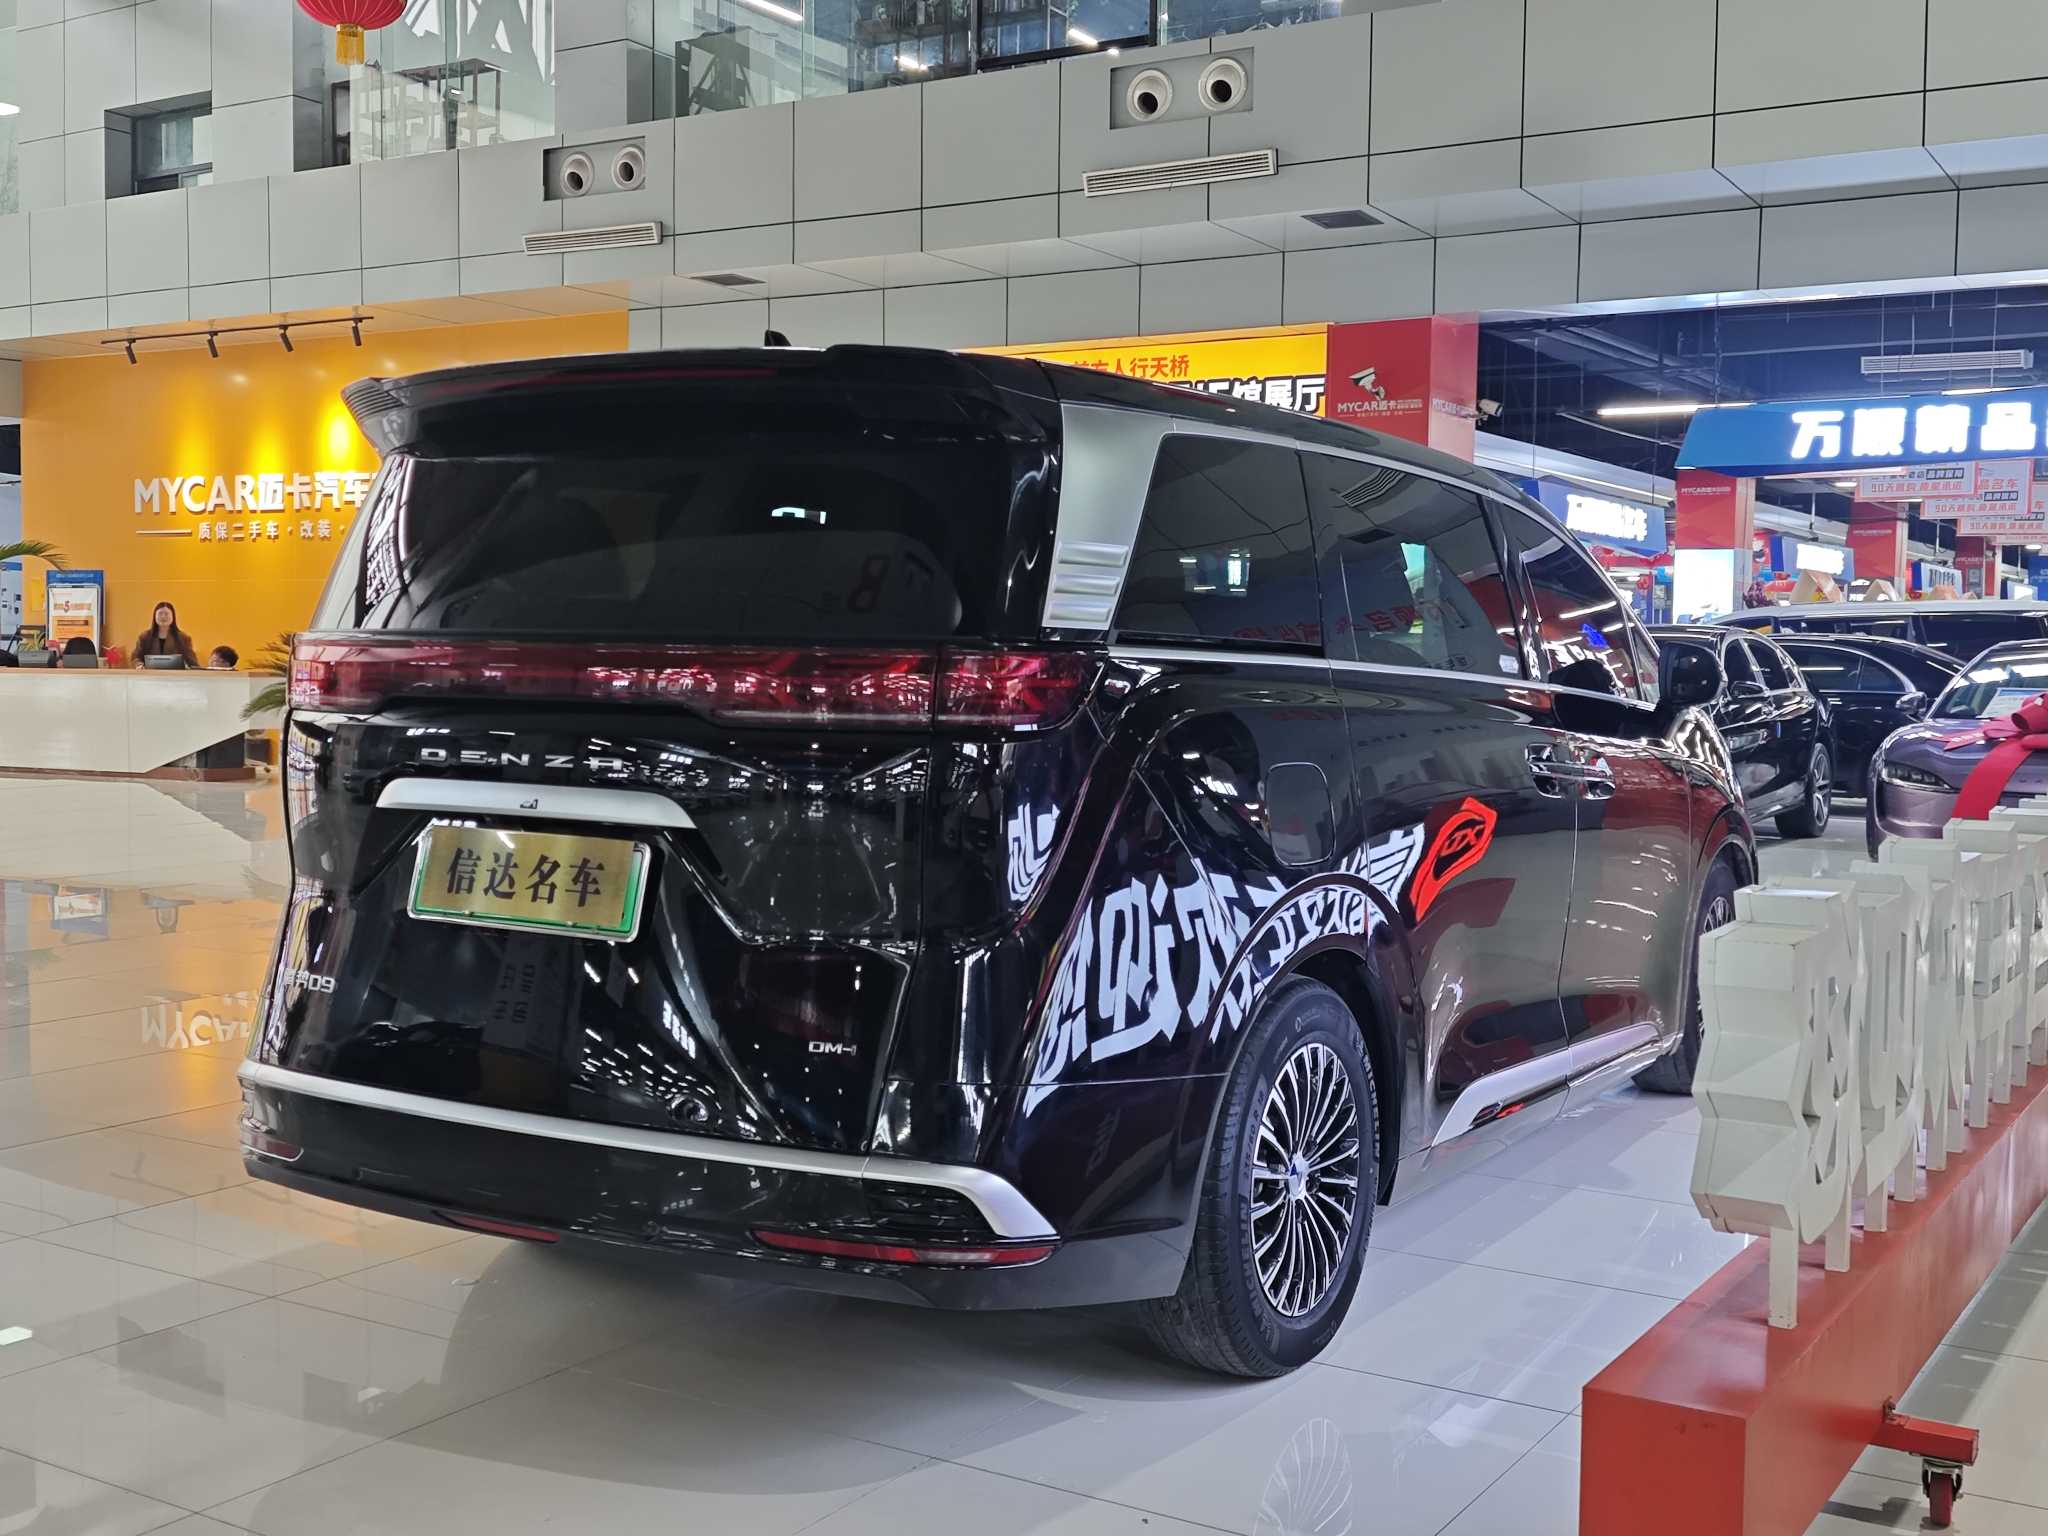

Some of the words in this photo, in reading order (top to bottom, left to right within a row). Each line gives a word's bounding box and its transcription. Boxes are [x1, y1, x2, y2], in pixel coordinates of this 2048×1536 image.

[420, 747, 624, 772] DENZA
[446, 847, 606, 908] 信达名车
